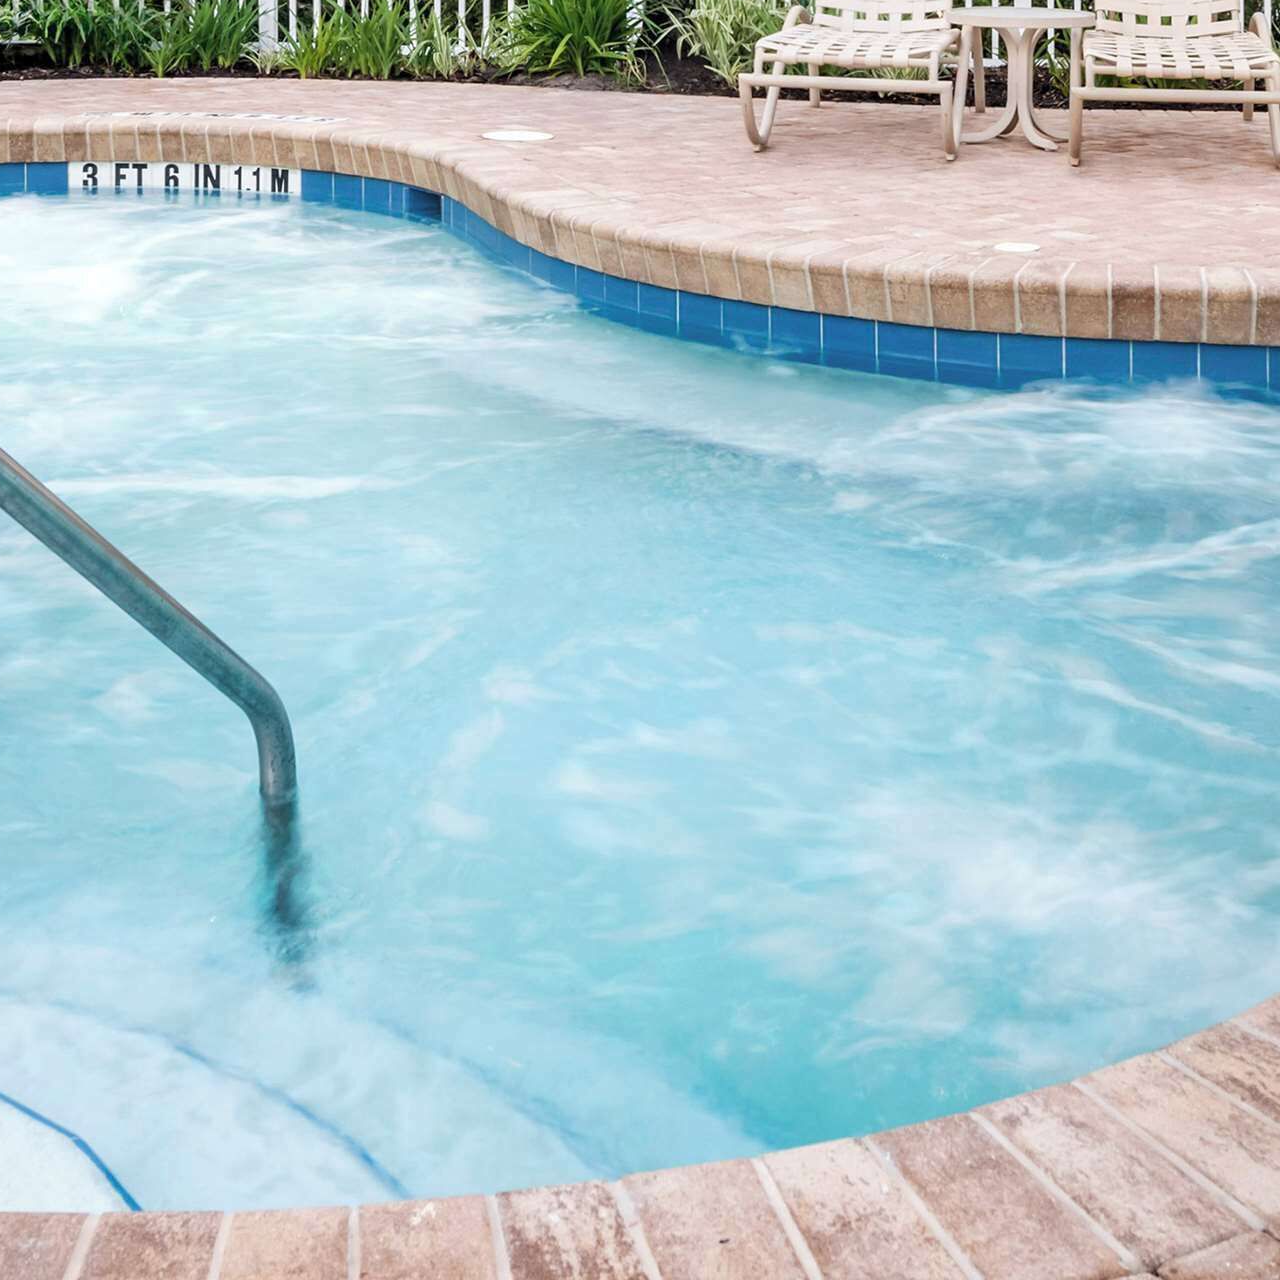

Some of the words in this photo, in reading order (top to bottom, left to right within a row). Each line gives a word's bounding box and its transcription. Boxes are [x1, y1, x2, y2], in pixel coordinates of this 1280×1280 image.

[82, 163, 99, 188] 3
[114, 163, 148, 188] FT
[164, 164, 180, 188] 6
[234, 166, 261, 192] 1.1
